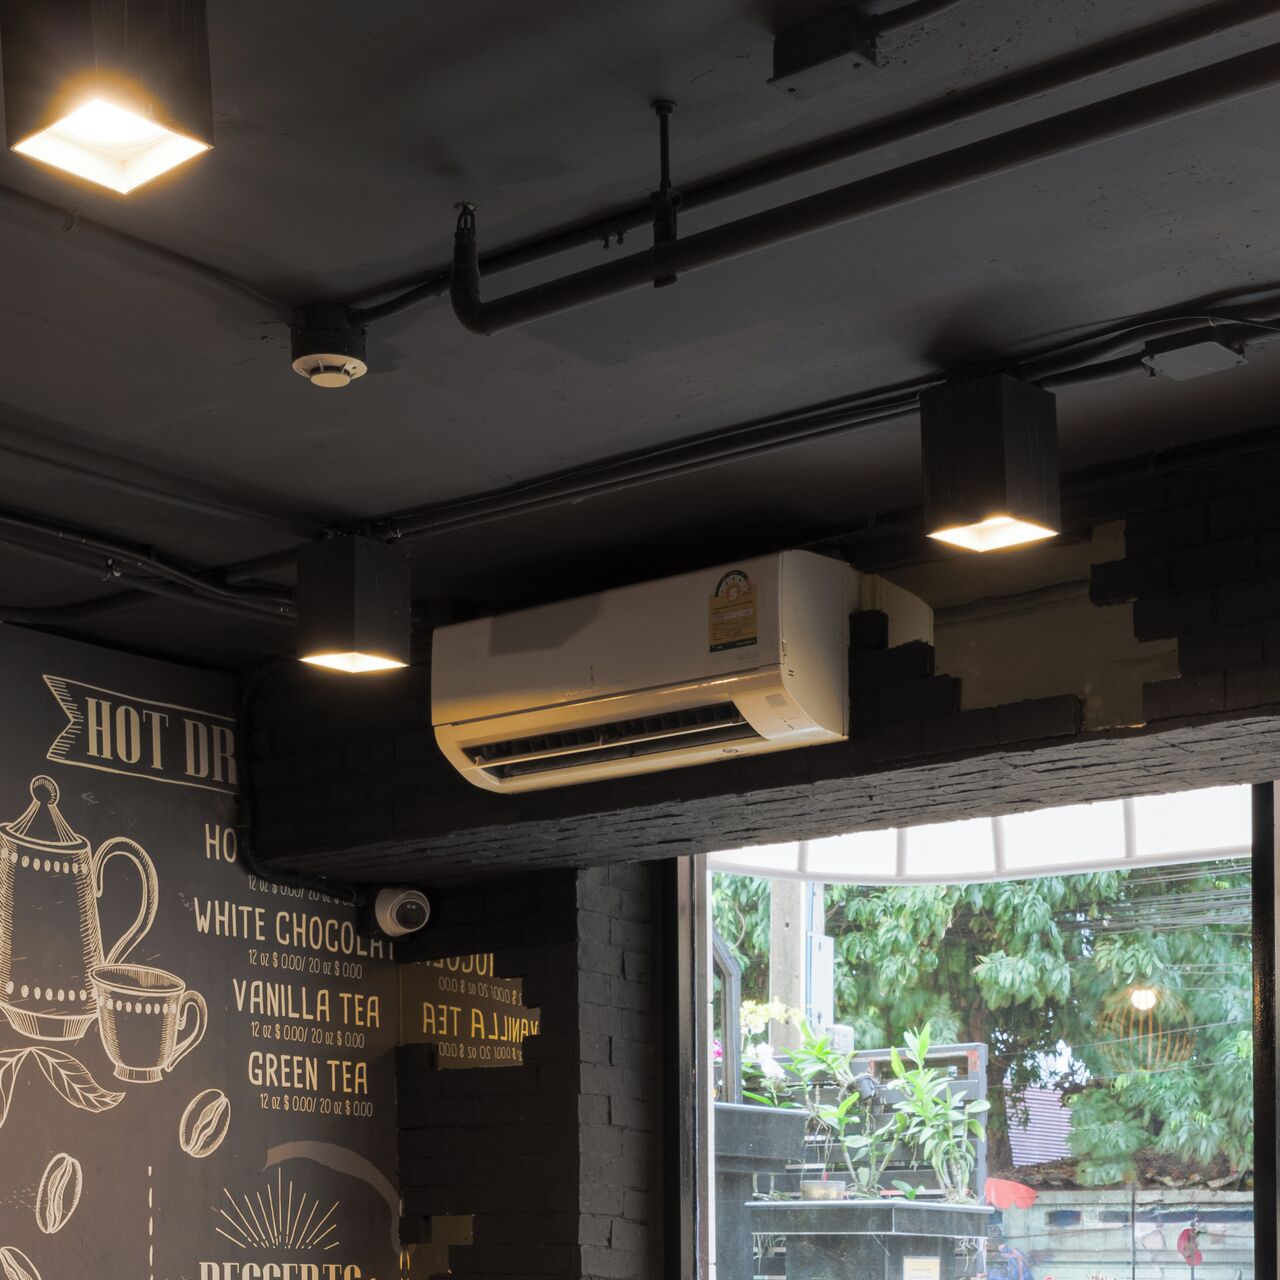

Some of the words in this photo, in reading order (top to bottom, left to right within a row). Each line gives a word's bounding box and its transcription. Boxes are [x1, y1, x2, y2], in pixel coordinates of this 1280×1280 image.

[85, 697, 168, 769] HOT
[194, 897, 266, 941] WHITE
[249, 949, 256, 965] 12
[260, 953, 269, 966] oz
[272, 952, 278, 968] $
[281, 954, 305, 972] 0.00/
[309, 957, 320, 973] 20
[323, 962, 332, 975] oz
[335, 961, 340, 976] $
[342, 962, 362, 979] 0.00
[233, 978, 330, 1022] VANILLA
[339, 993, 380, 1028] TEA
[251, 1021, 259, 1037] 12
[263, 1025, 271, 1038] oz
[275, 1024, 280, 1040] $
[284, 1025, 308, 1042] 0.00/
[311, 1028, 322, 1043] 20
[325, 1033, 334, 1045] oz
[337, 1031, 342, 1046] $
[345, 1033, 364, 1048] 0.00
[248, 1052, 318, 1091] GREEN
[327, 1060, 368, 1094] TEA
[260, 1093, 268, 1109] 12
[272, 1097, 280, 1109] oz
[284, 1094, 289, 1111] $
[293, 1096, 317, 1113] 0.00/
[320, 1098, 331, 1114] 20
[334, 1102, 342, 1114] oz
[345, 1100, 351, 1116] $
[354, 1101, 373, 1117] 0.00
